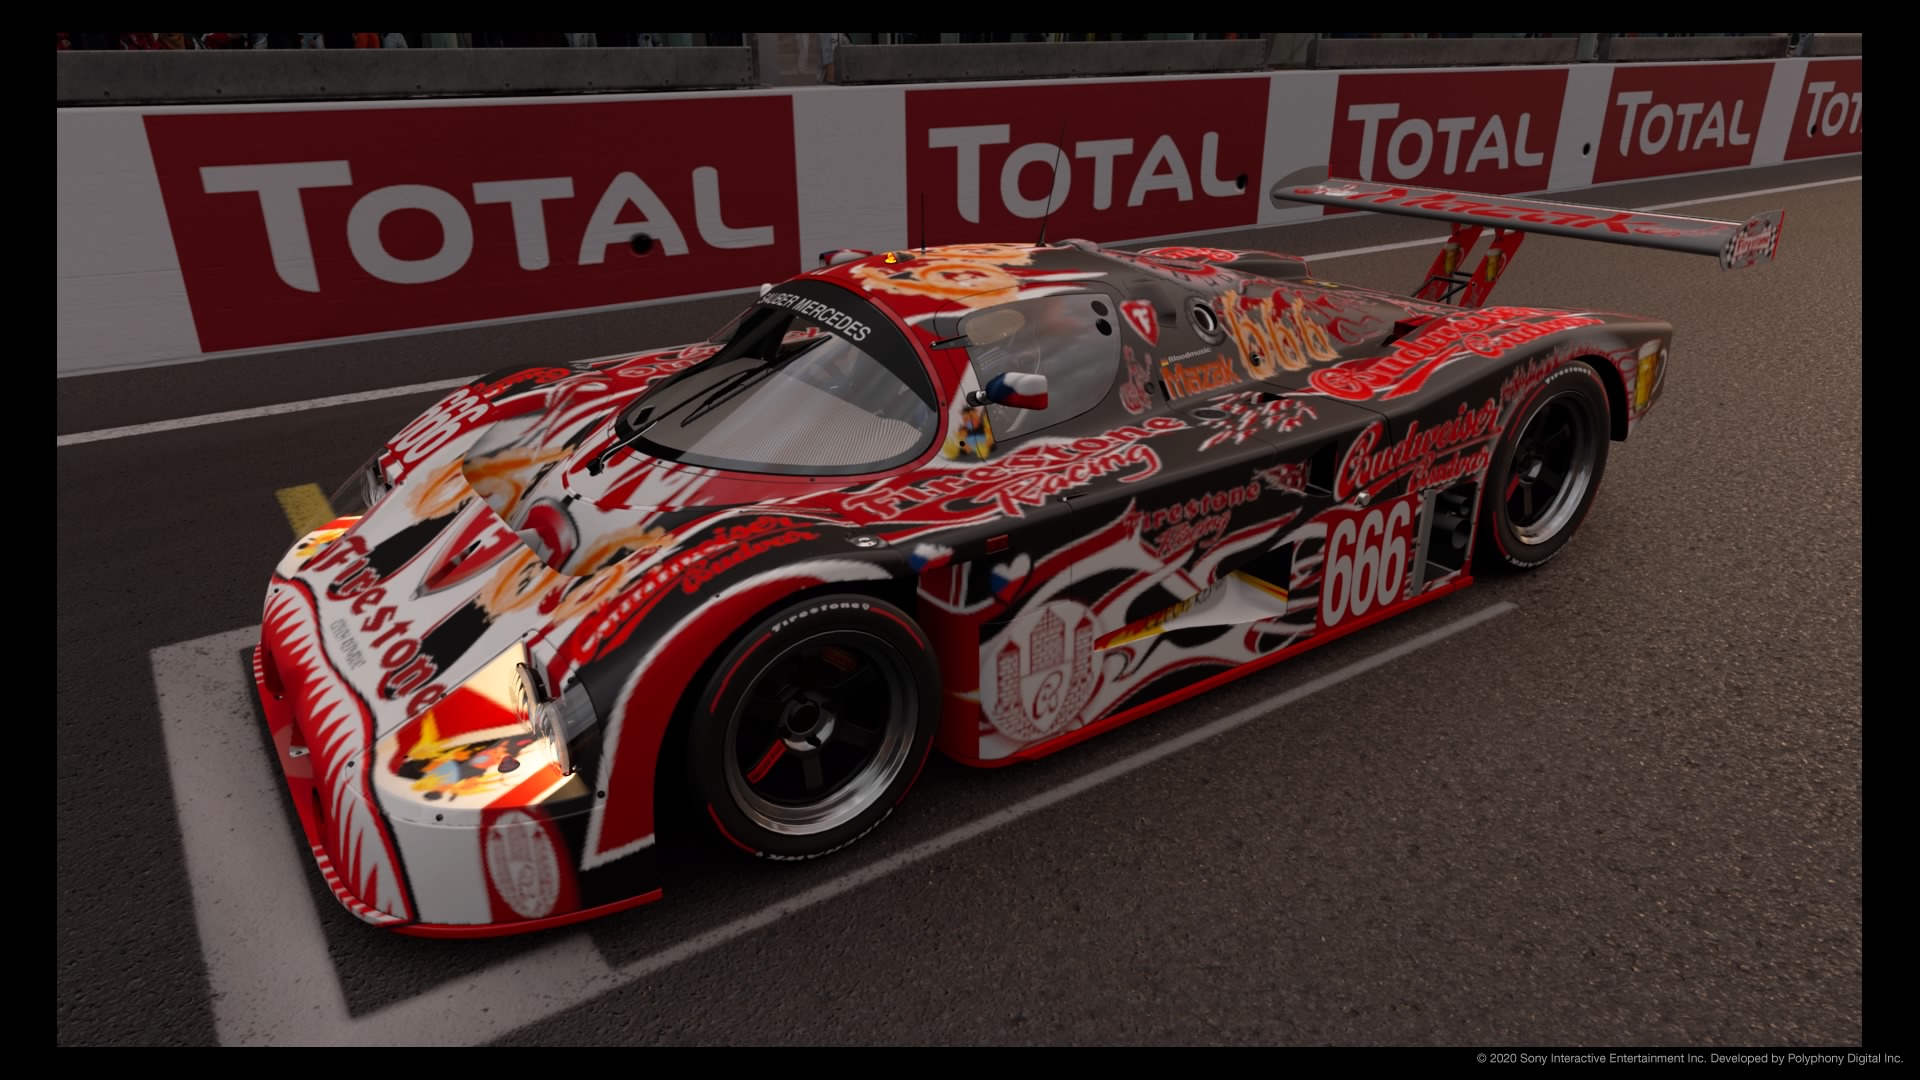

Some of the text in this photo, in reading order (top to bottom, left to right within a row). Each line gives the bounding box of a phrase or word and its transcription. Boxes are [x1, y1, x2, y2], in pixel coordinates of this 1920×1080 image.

[1347, 102, 1545, 182] TOTAL
[1616, 90, 1751, 157] TOTAL
[1806, 80, 1862, 138] TOT
[928, 123, 1246, 224] TOTAL
[199, 159, 775, 294] TOTAL
[791, 297, 872, 342] MERCEDES
[1161, 352, 1243, 401] Mazak
[841, 414, 1190, 522] Firestone
[980, 442, 1163, 520] Racing
[1123, 481, 1262, 541] Firestone
[1321, 500, 1411, 628] 666
[297, 533, 450, 718] Firestone
[770, 602, 859, 634] Firestone
